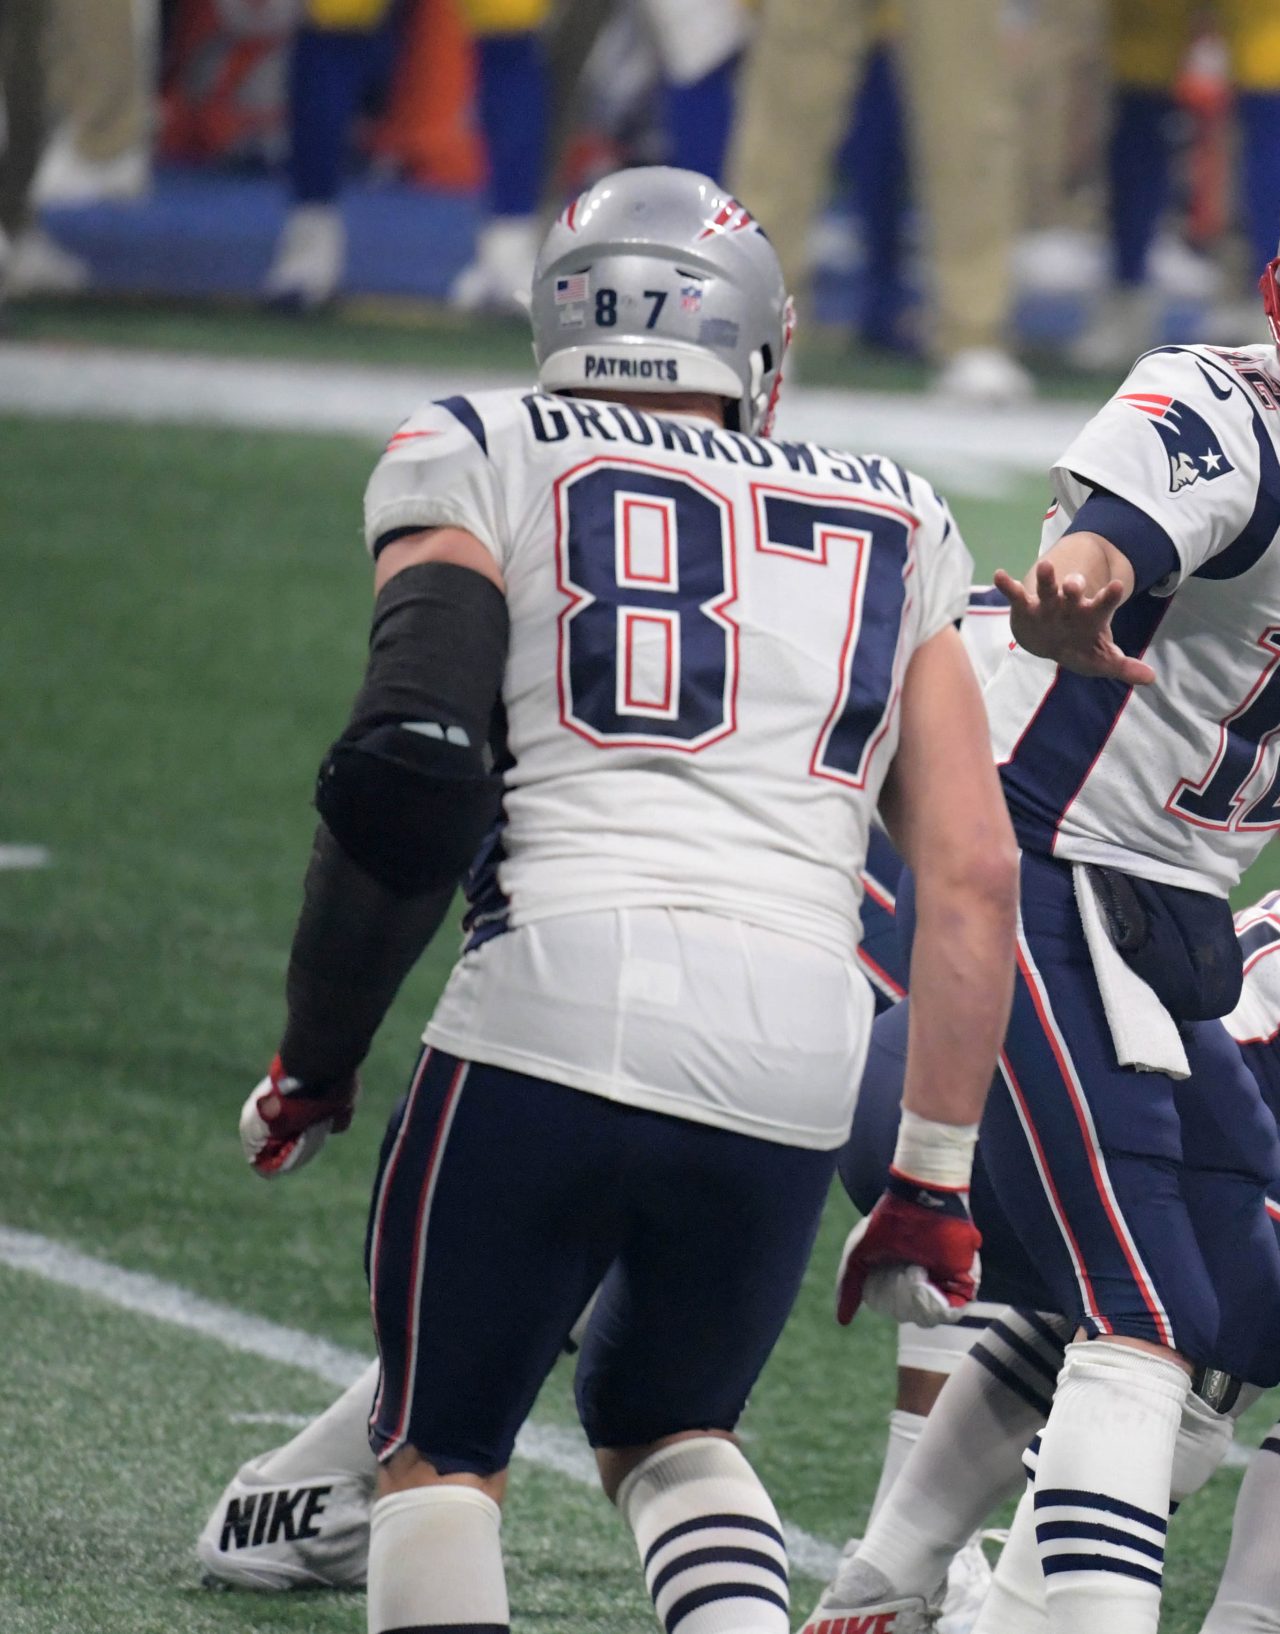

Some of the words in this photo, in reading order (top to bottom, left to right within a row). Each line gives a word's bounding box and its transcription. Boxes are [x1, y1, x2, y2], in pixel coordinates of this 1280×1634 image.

[585, 354, 678, 382] PATRIOTS
[553, 456, 921, 790] 87
[219, 1485, 333, 1553] NIKE
